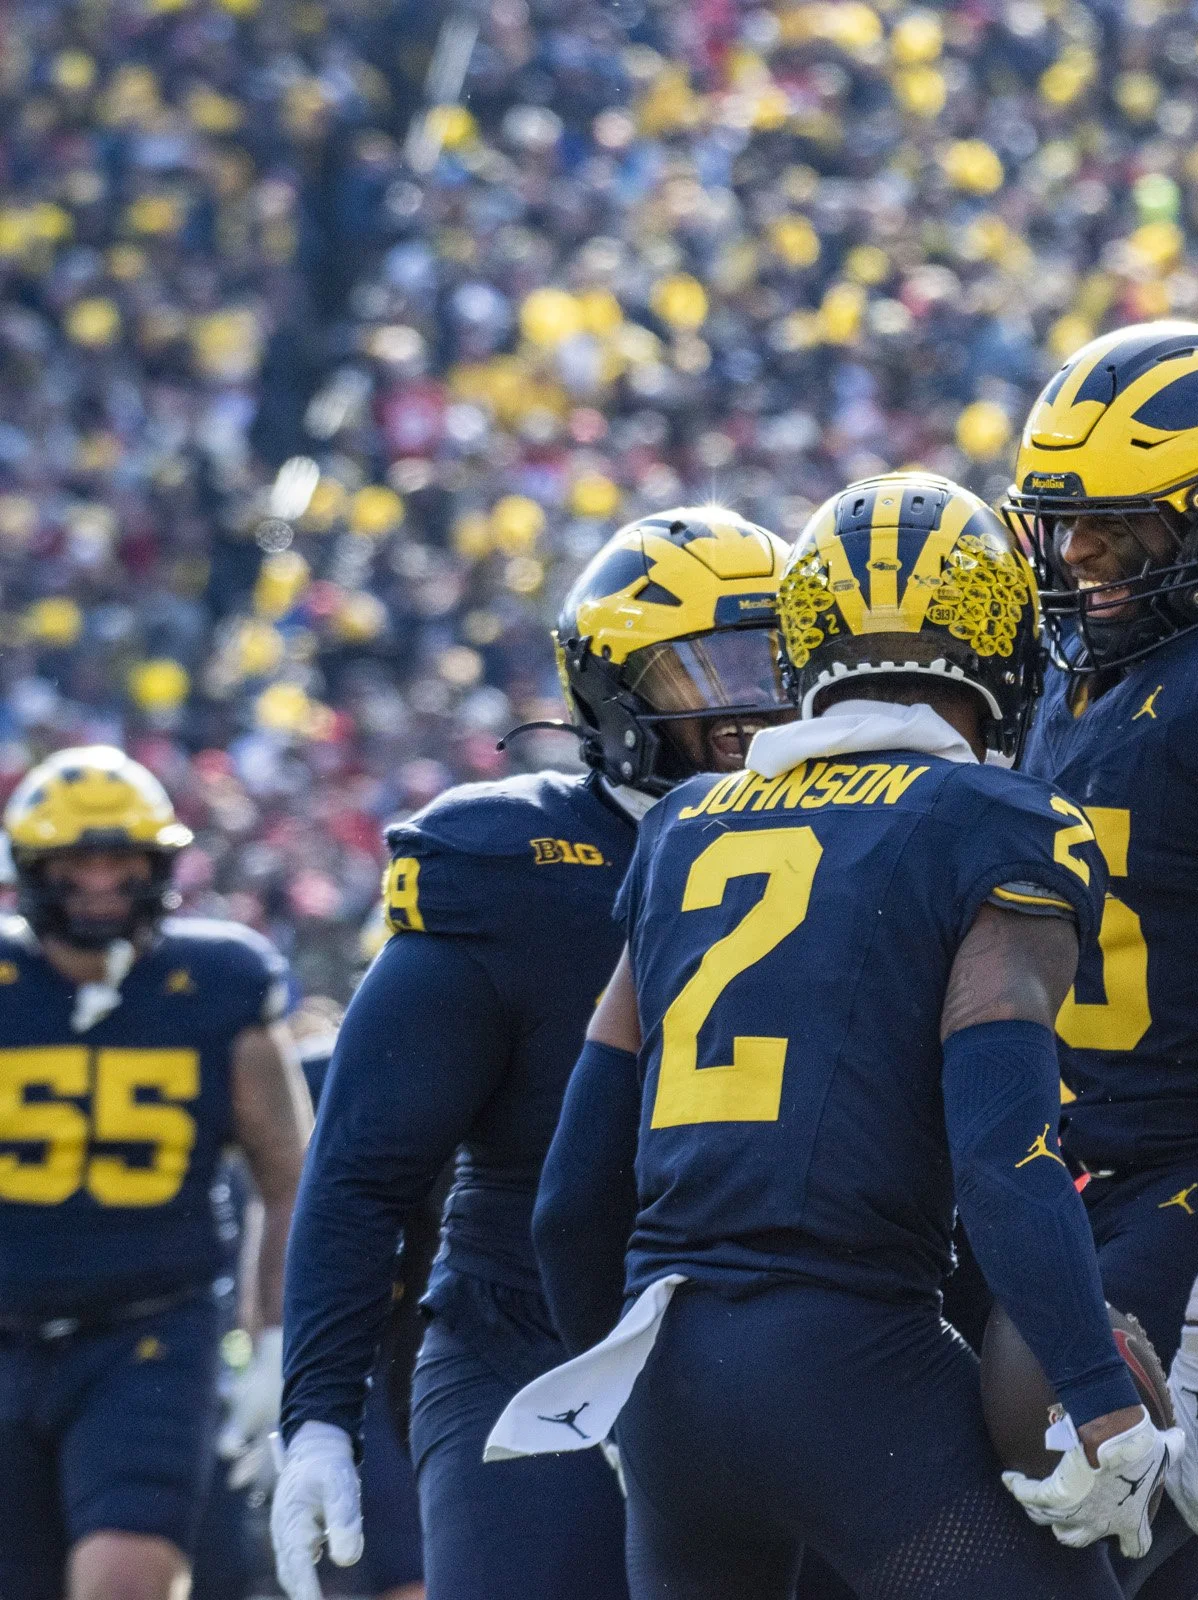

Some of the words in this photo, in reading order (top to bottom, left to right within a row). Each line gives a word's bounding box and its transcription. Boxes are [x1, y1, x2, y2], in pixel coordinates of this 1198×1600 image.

[825, 613, 841, 635] 2
[678, 761, 932, 821] JOHNSON
[1049, 793, 1096, 887] 2
[650, 826, 824, 1130] 2
[0, 1045, 199, 1208] 55
